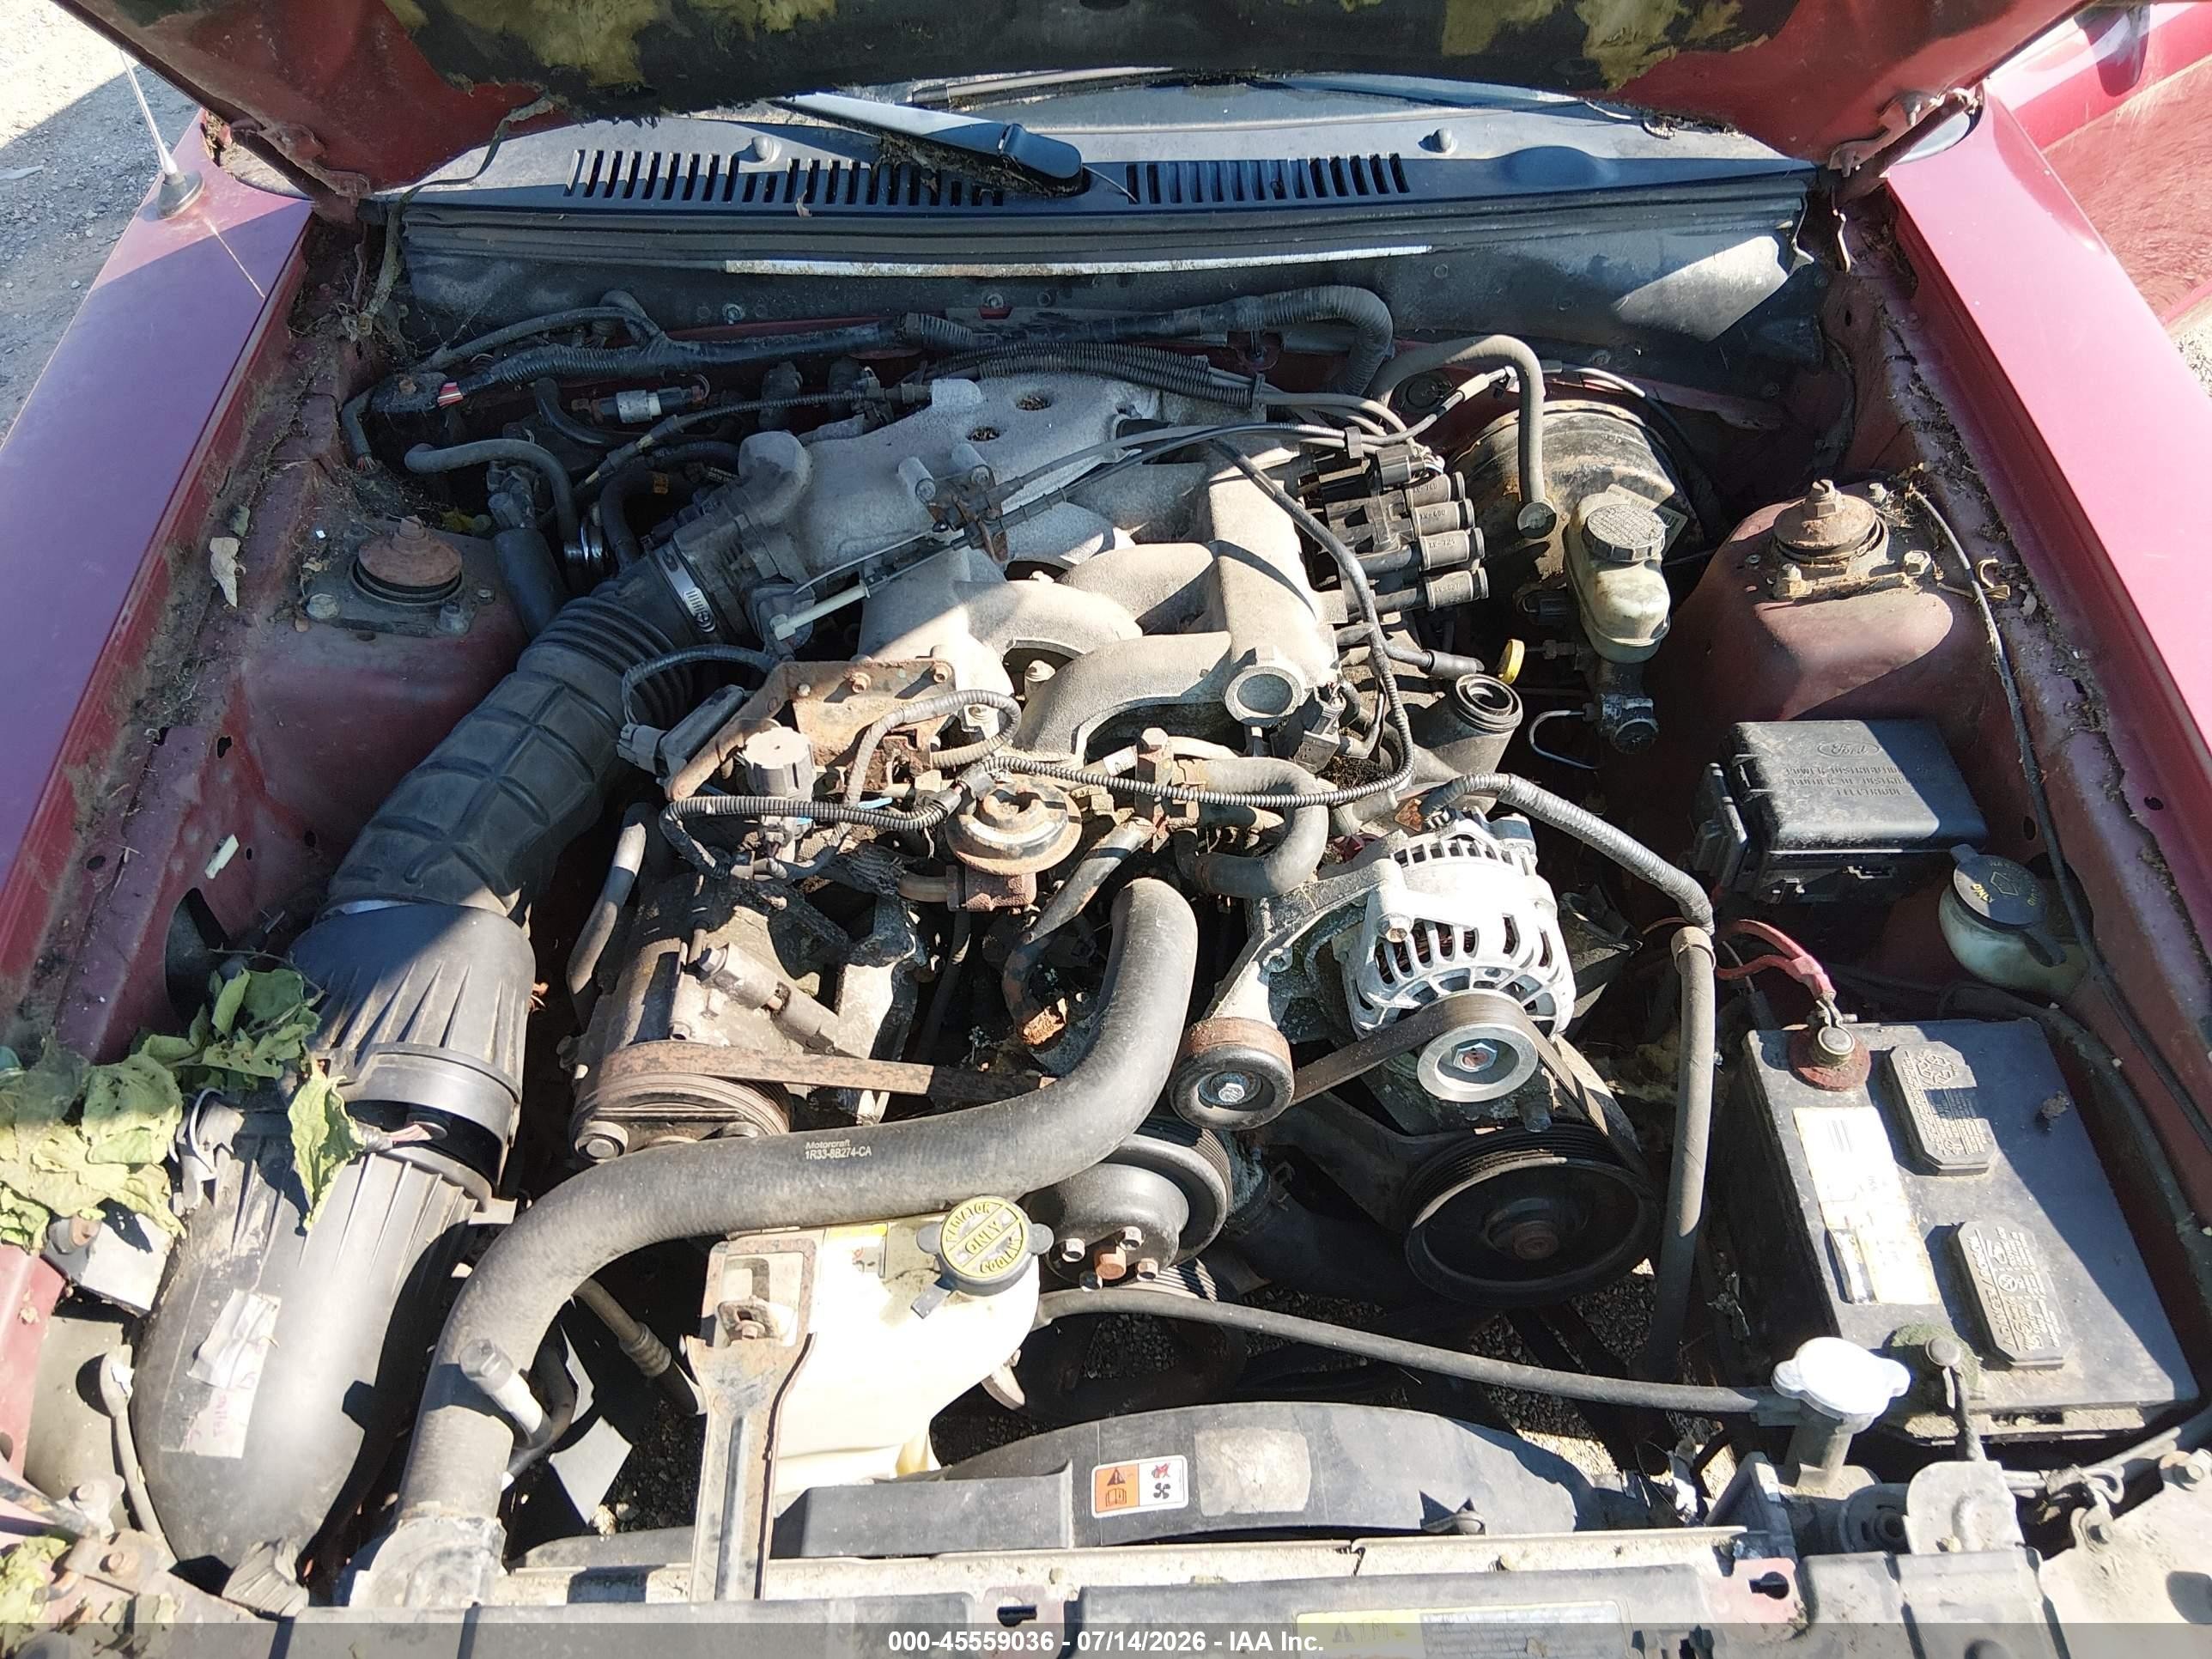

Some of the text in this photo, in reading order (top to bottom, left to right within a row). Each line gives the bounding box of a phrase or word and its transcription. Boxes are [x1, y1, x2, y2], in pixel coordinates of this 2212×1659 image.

[1831, 743, 1868, 755] Ford
[805, 1139, 851, 1150] Motorcraft
[805, 1146, 872, 1160] 1R33-8B274-CA
[945, 1202, 990, 1243] RADIATOR
[965, 1220, 1001, 1255] ONLY
[980, 1234, 1021, 1273] COOLANT
